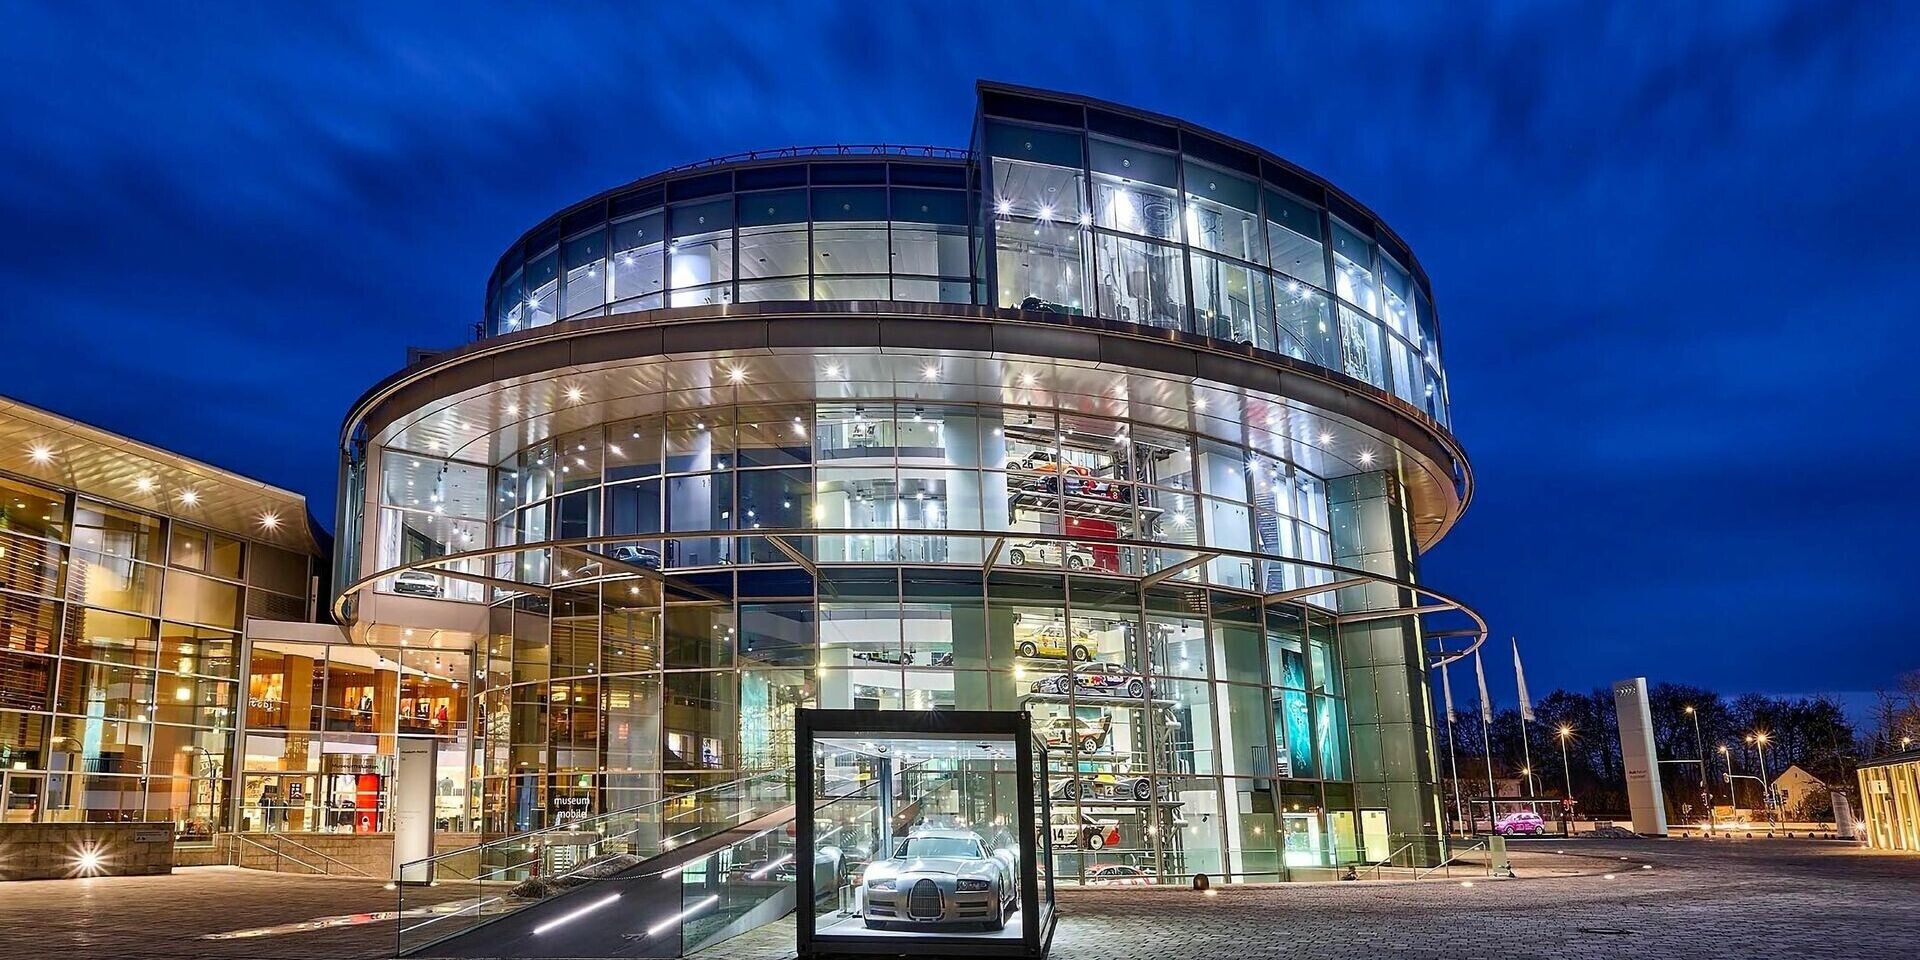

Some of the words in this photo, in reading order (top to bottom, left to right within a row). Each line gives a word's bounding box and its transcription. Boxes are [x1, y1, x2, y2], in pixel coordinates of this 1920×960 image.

[1022, 459, 1034, 469] 26
[1060, 729, 1068, 743] 1
[1105, 785, 1113, 795] 2
[553, 796, 590, 805] museum
[557, 808, 587, 819] mobile
[1052, 828, 1065, 841] 14
